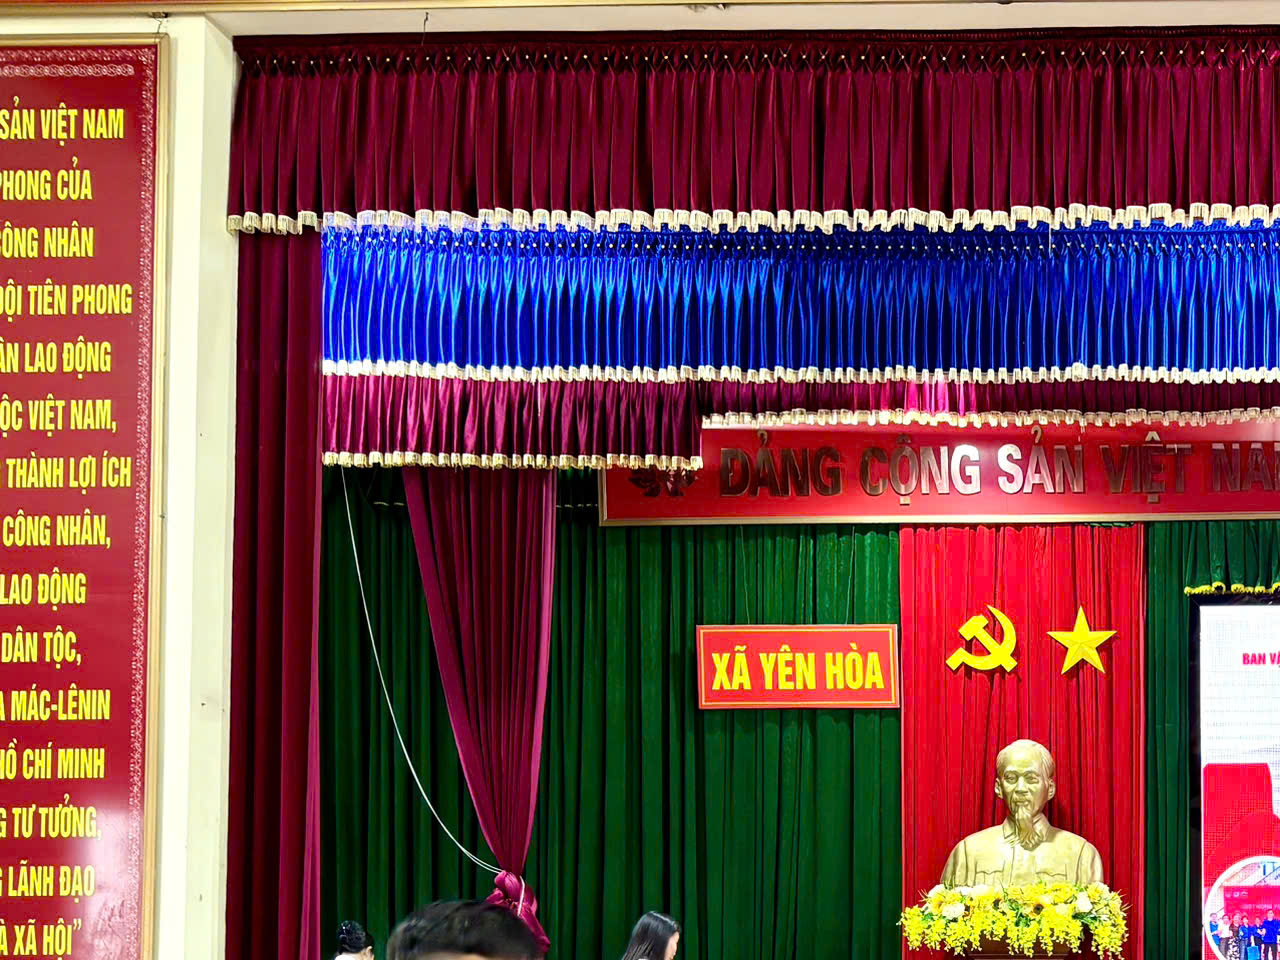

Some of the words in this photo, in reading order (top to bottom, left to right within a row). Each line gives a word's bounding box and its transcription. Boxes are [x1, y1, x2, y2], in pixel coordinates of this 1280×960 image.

[0, 96, 35, 140] SẢN
[41, 102, 78, 146] VIỆT
[83, 109, 124, 139] NAM
[0, 170, 51, 200] HONG
[57, 156, 92, 200] CỦA
[0, 220, 38, 258] ÔNG
[44, 220, 93, 257] NHÂN
[28, 278, 66, 315] TIÊN
[72, 284, 132, 315] PHONG
[25, 342, 57, 373] LAO
[62, 335, 111, 379] ĐỘNG
[28, 393, 65, 437] VIỆT
[70, 399, 116, 433] NAM,
[6, 451, 63, 488] THÀNH
[69, 455, 96, 495] LỢI
[102, 450, 131, 487] ÍCH
[720, 430, 842, 496] ĐẢNG
[860, 434, 981, 505] CỘNG
[997, 426, 1083, 493] SẢN
[1099, 431, 1192, 503] VIỆT
[3, 509, 50, 547] CÔNG
[56, 508, 111, 549] NHÂN,
[0, 574, 32, 604] LAO
[37, 567, 86, 611] ĐỘNG
[2, 625, 37, 662] DÂN
[43, 625, 81, 669] TỘC,
[712, 645, 752, 690] XÃ
[759, 644, 816, 690] YÊN
[825, 643, 884, 689] HÒA
[1243, 652, 1266, 665] BAN
[11, 683, 110, 721] MÁC-LÊNIN
[23, 742, 52, 779] CHÍ
[58, 748, 104, 778] MINH
[12, 804, 36, 838] TƯ
[39, 793, 102, 840] TƯỞNG,
[8, 860, 54, 896] LÃNH
[60, 865, 94, 903] ĐẠO
[13, 919, 37, 955] XÃ
